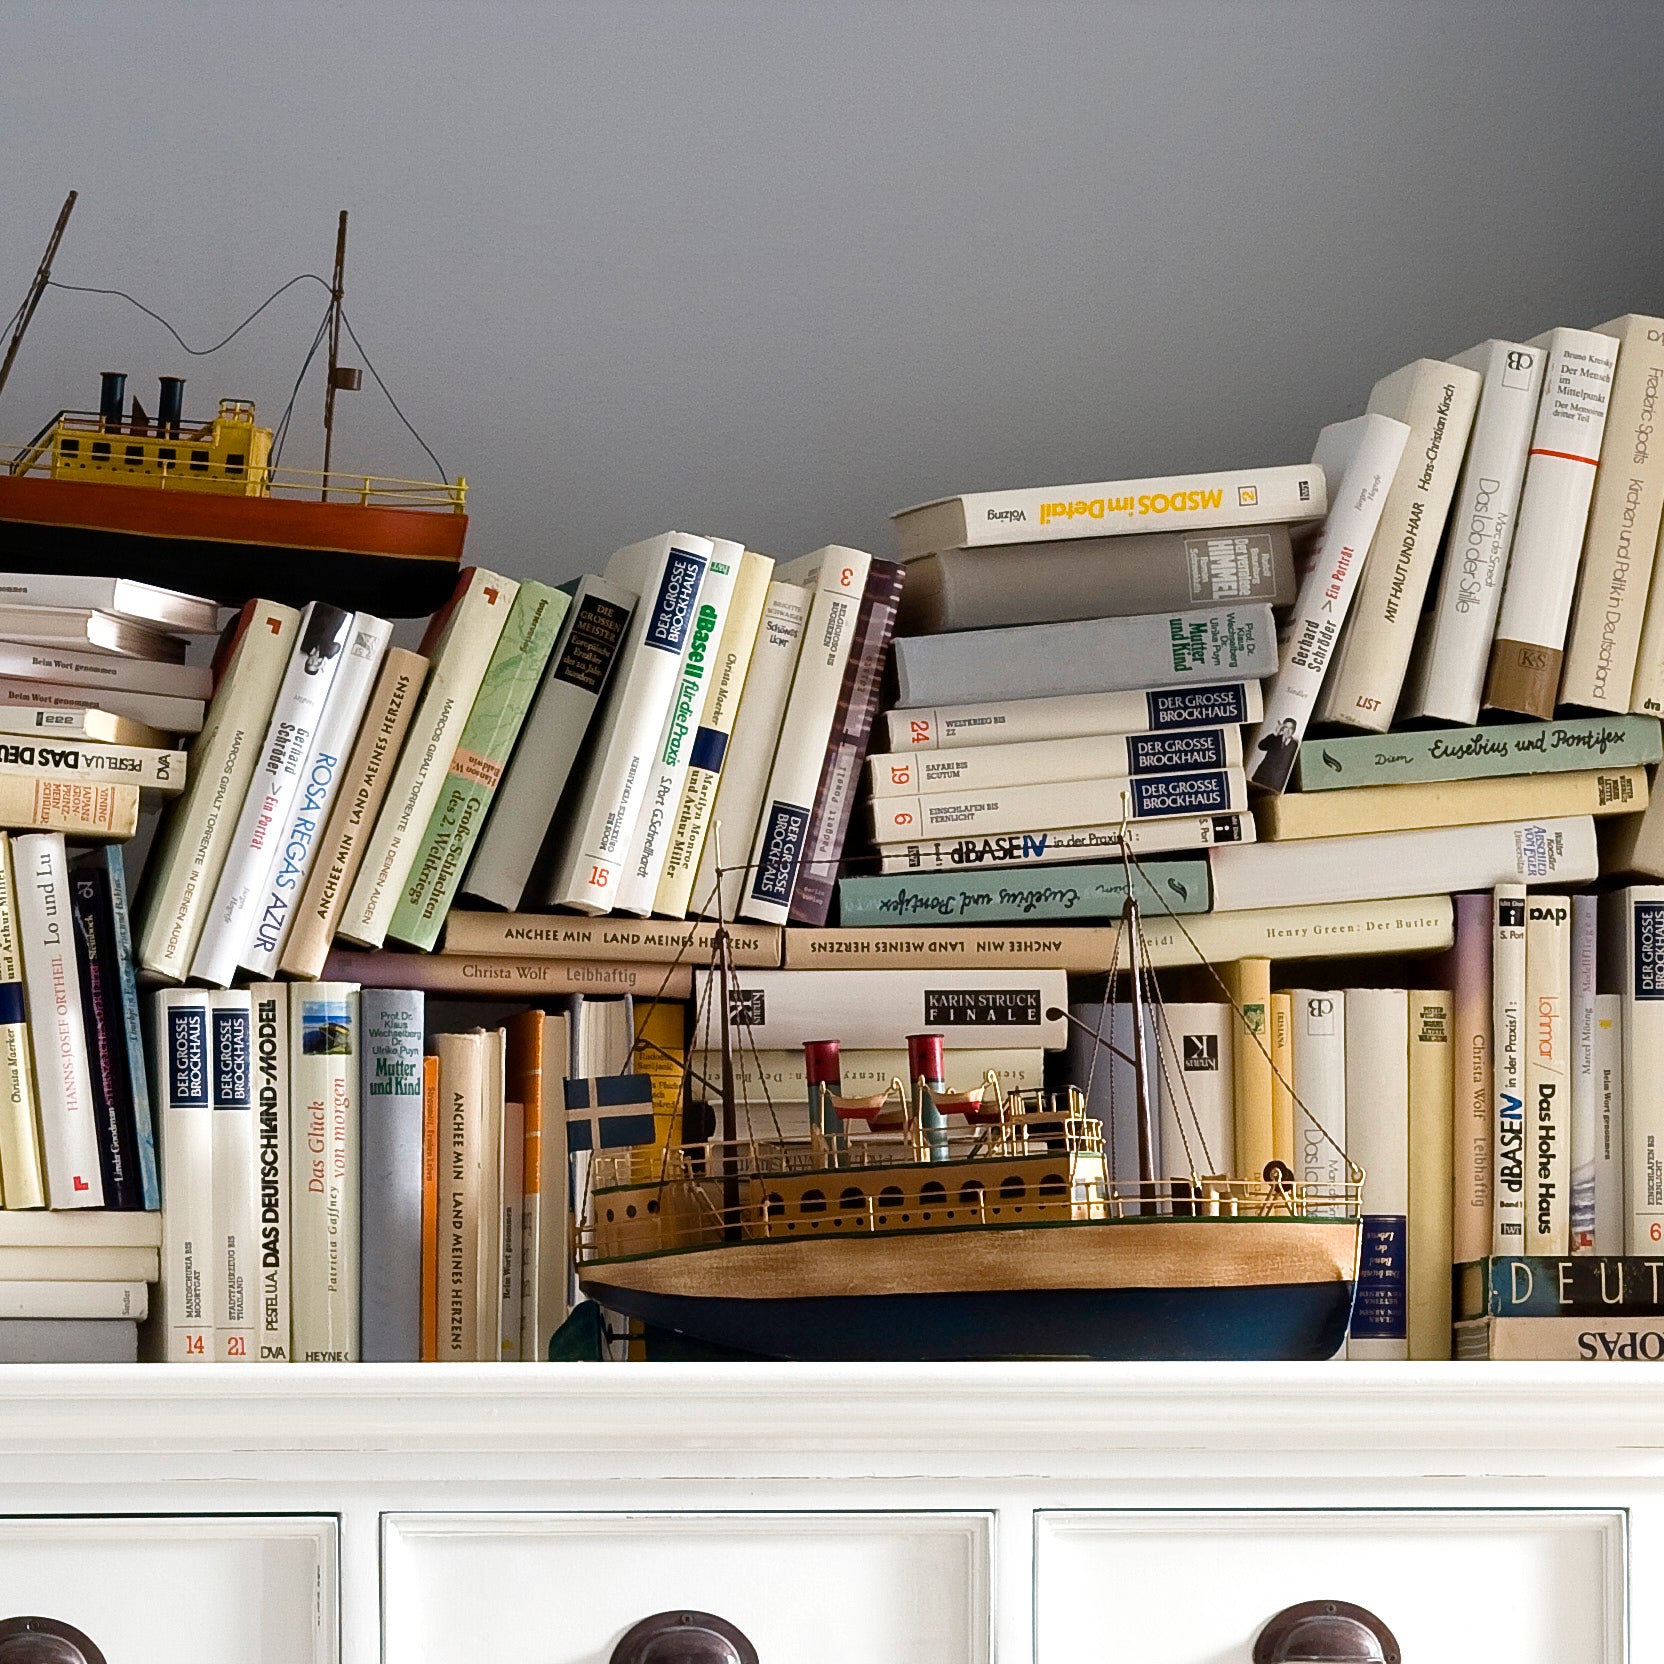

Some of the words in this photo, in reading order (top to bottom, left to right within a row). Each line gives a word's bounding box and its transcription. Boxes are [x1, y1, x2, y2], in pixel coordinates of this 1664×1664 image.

[1558, 376, 1570, 385] im
[1561, 365, 1578, 376] Der
[1580, 368, 1610, 383] Mensch
[1439, 384, 1455, 416] Kirsch
[1557, 386, 1605, 404] Mittelpunkt
[1418, 416, 1447, 491] Hans-Christian
[1040, 499, 1105, 524] Detail
[1108, 496, 1134, 516] im
[1138, 489, 1223, 514] MSDOS
[988, 509, 1026, 522] Völzing
[1407, 502, 1424, 539] HAAR
[1401, 538, 1416, 564] UND
[1332, 547, 1354, 583] Porträt
[1326, 580, 1341, 599] Ein
[1394, 565, 1410, 596] HAUT
[1384, 593, 1400, 623] MIT
[1292, 620, 1319, 666] Gerhard
[1308, 621, 1336, 672] Schröder
[1158, 696, 1182, 709] DER
[1184, 692, 1236, 707] GROSSE
[1159, 705, 1237, 722] BROCKHAUS
[1356, 696, 1381, 711] LIST
[910, 720, 929, 743] 24
[38, 748, 80, 769] DAS
[1138, 742, 1163, 754] DER
[1165, 737, 1214, 752] GROSSE
[1139, 750, 1216, 766] BROCKHAUS
[157, 754, 170, 780] DVA
[892, 765, 909, 784] 19
[927, 770, 960, 779] SCUTUM
[317, 864, 344, 919] ANCHEE
[338, 835, 352, 866] MIN
[350, 789, 370, 824] LAND
[364, 739, 388, 790] MEINES
[384, 675, 409, 737] HERZENS
[446, 791, 465, 816] des
[439, 815, 449, 829] 2.
[454, 798, 480, 842] Große
[37, 853, 52, 876] Lu
[409, 831, 451, 905] Weltkriegs
[588, 866, 609, 887] 15
[423, 843, 462, 919] Schlachten
[38, 880, 56, 916] und
[44, 918, 61, 946] Lo
[50, 954, 68, 1015] ORTHEIL
[930, 995, 975, 1006] KARIN
[978, 995, 1037, 1006] STRUCK
[930, 1009, 1037, 1021] FINALE
[56, 1019, 77, 1112] HANNS-JOSEF
[332, 1078, 350, 1142] morgen
[1538, 1084, 1556, 1122] Das
[307, 1101, 325, 1153] Glück
[334, 1146, 346, 1178] von
[1538, 1129, 1556, 1179] Hohe
[309, 1158, 324, 1193] Das
[328, 1187, 339, 1235] Gaffney
[1538, 1182, 1556, 1234] Haus
[328, 1241, 338, 1291] Patricia
[187, 1336, 205, 1355] 14
[228, 1337, 246, 1356] 21
